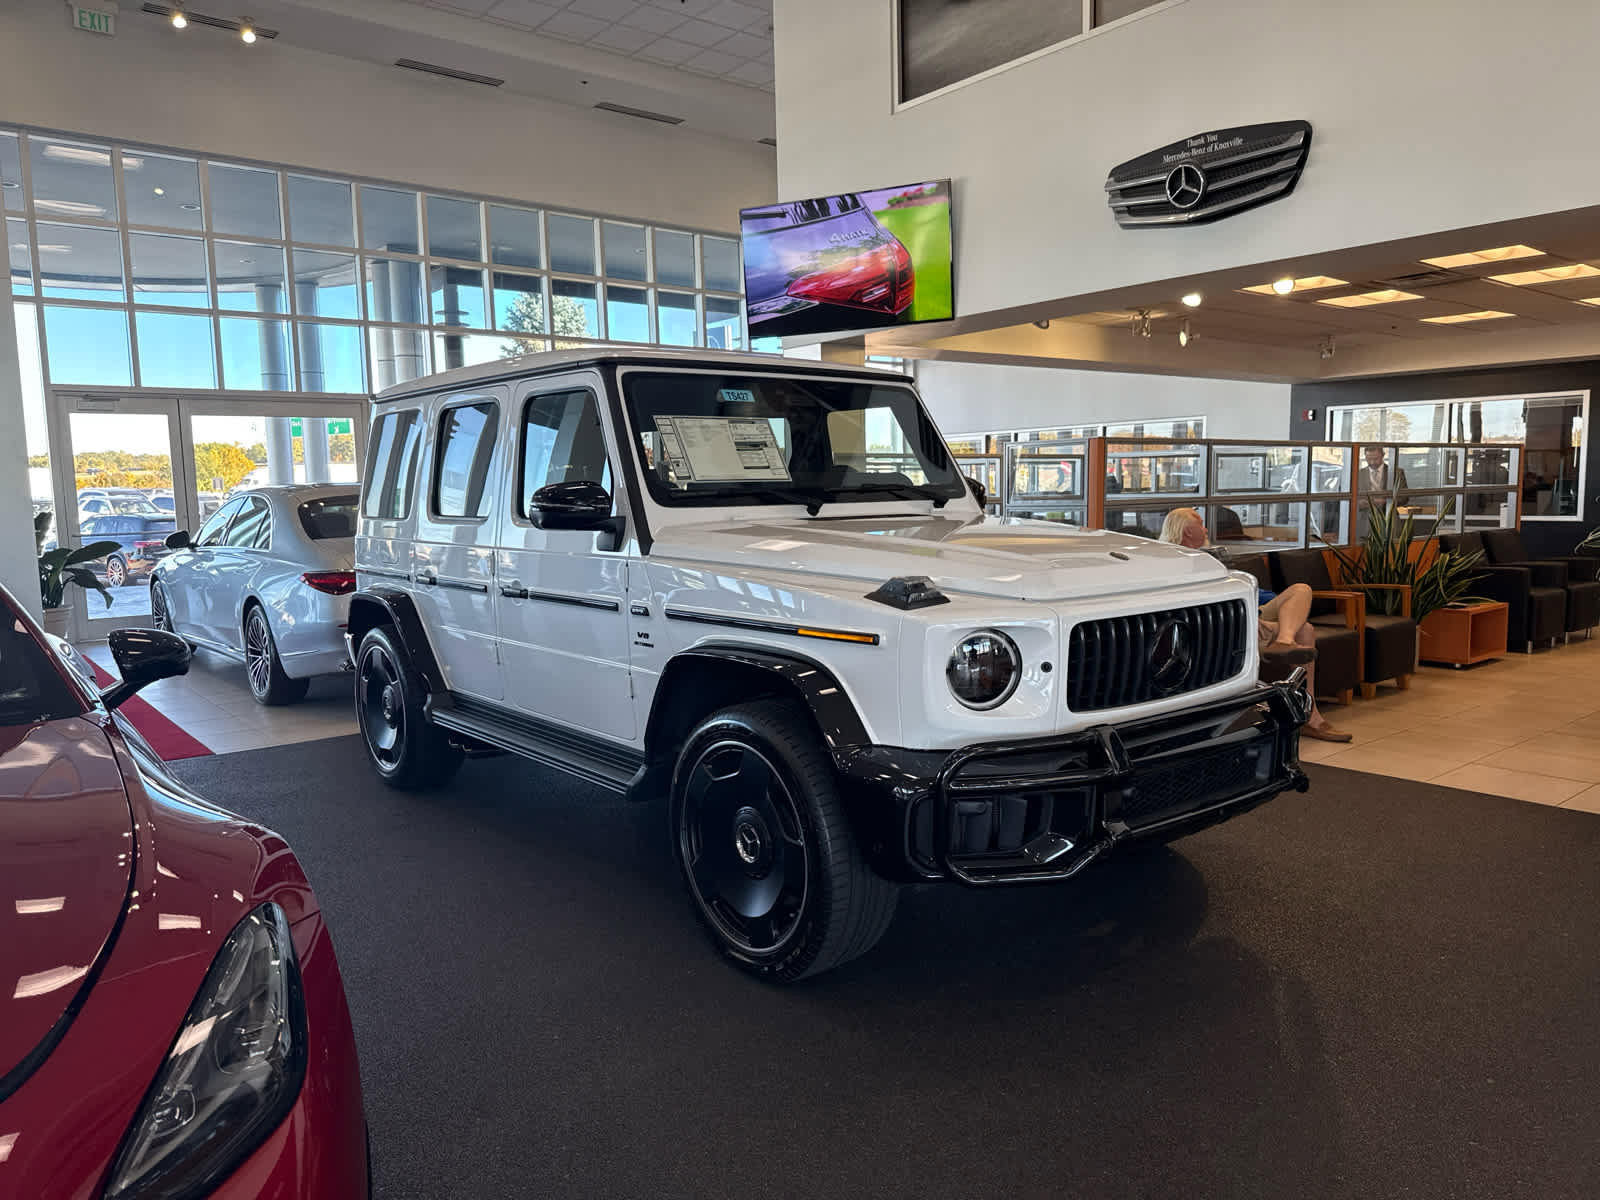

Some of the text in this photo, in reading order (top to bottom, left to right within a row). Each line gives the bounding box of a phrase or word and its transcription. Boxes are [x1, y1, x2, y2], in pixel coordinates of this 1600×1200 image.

[78, 10, 112, 33] EXIT
[1163, 147, 1205, 162] Mercedes-Benz
[1214, 137, 1243, 151] Knoxville
[1186, 134, 1218, 147] Thank You
